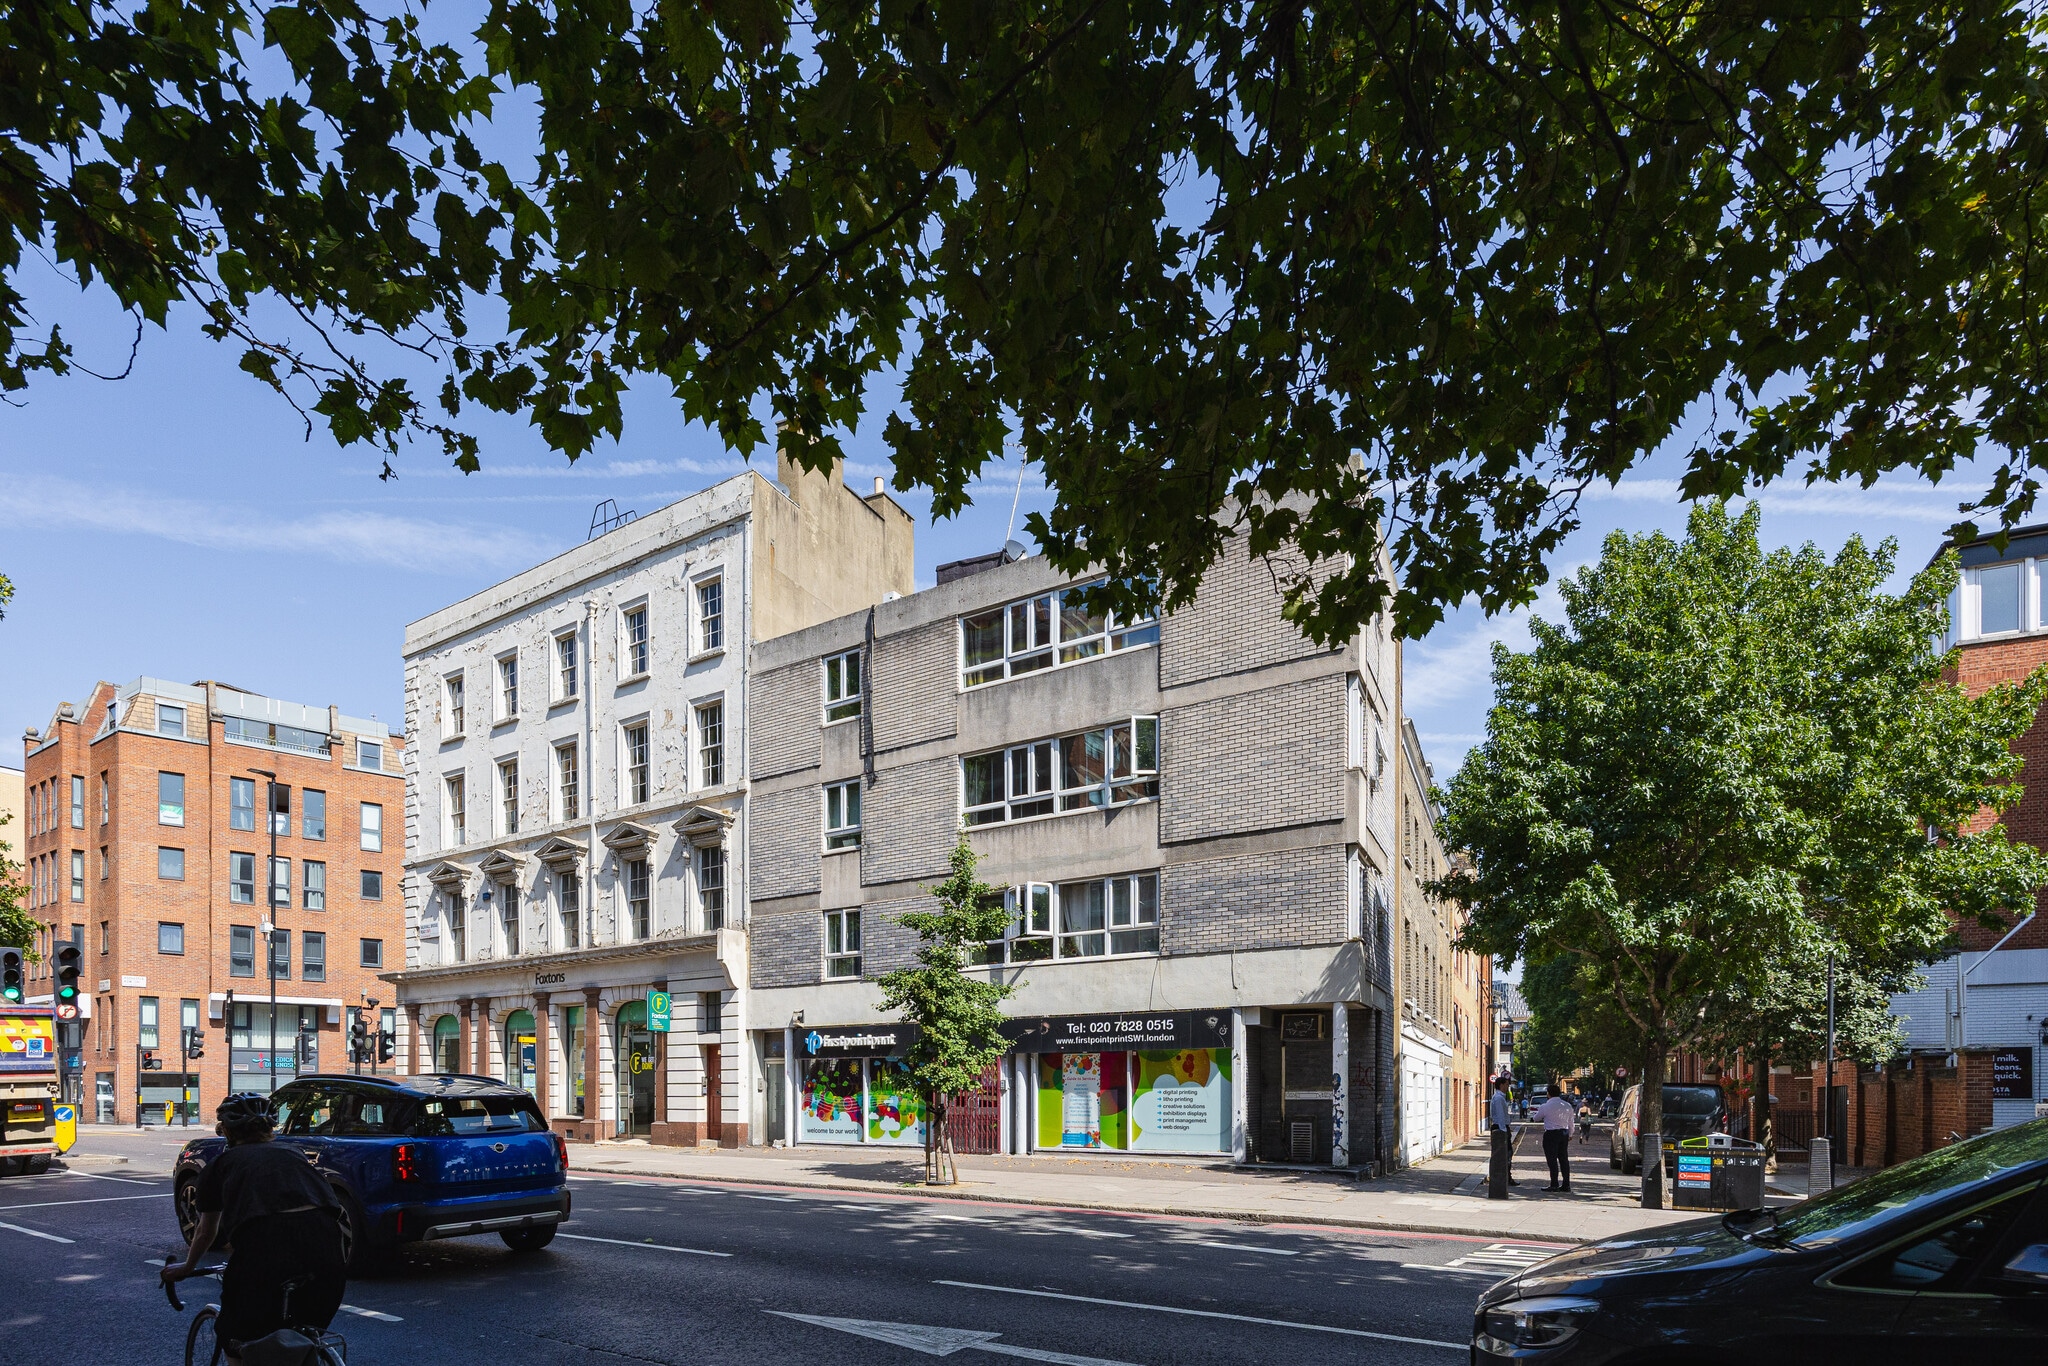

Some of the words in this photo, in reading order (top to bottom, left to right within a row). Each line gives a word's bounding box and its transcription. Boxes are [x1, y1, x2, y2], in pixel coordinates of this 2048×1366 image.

[535, 972, 566, 985] Foxtons
[656, 997, 663, 1010] F
[1066, 1023, 1086, 1033] Tel:
[1089, 1022, 1111, 1033] 020
[1114, 1020, 1143, 1032] 7828
[1146, 1019, 1174, 1031] 0515
[823, 1033, 896, 1050] firstpointprint
[1056, 1034, 1175, 1045] www.firstpointprintSW1.london
[1996, 1054, 2019, 1062] milk.
[1994, 1063, 2022, 1071] beans.
[1994, 1071, 2022, 1081] quick.
[451, 1162, 546, 1175] COUNTRYMAN
